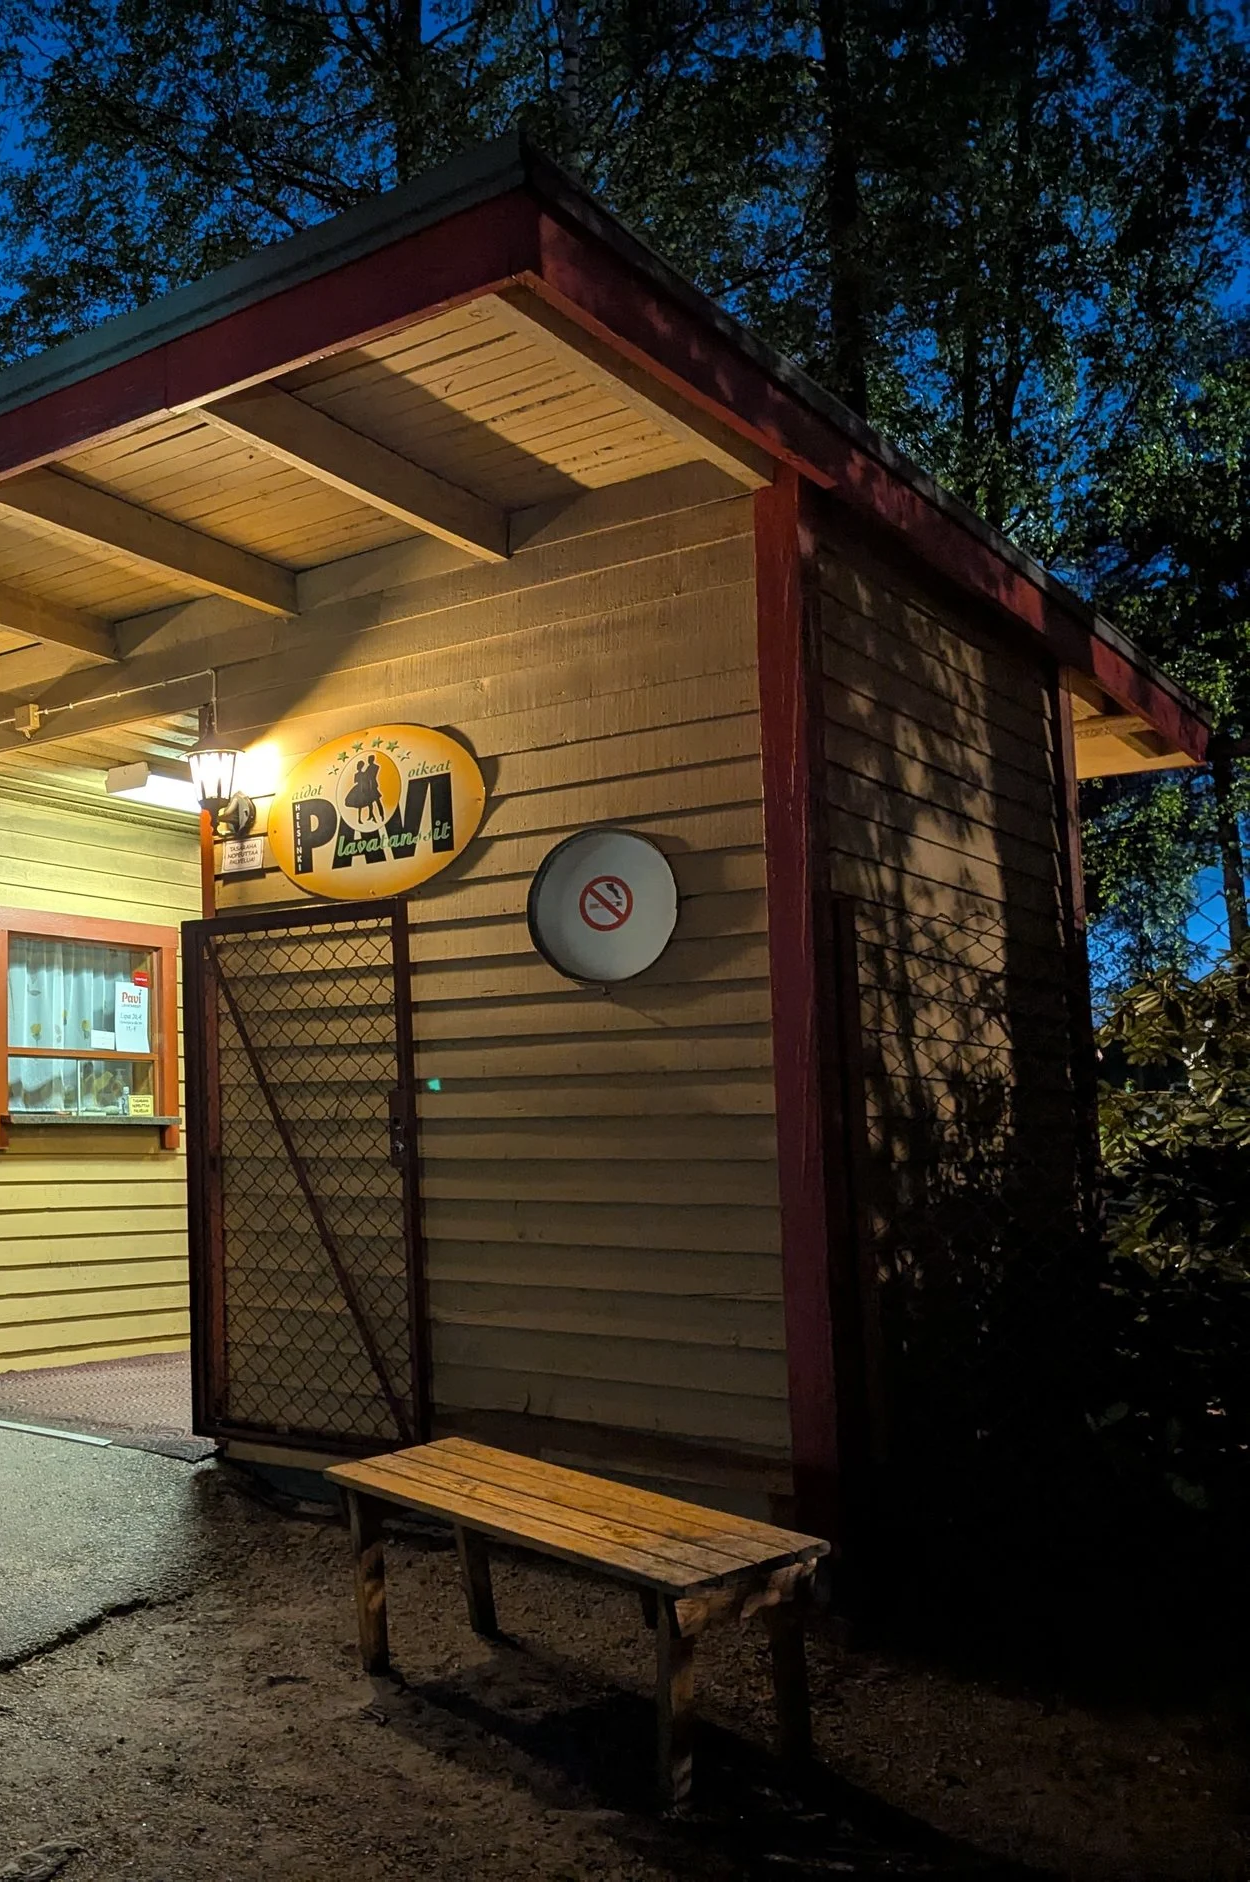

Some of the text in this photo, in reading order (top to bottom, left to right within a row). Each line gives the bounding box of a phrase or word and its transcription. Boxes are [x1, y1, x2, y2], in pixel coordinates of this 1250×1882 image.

[408, 760, 452, 778] oikeat
[292, 784, 323, 801] aidot
[291, 772, 455, 875] PAVI
[337, 820, 451, 857] lavatanssit
[121, 990, 142, 1004] Pavi
